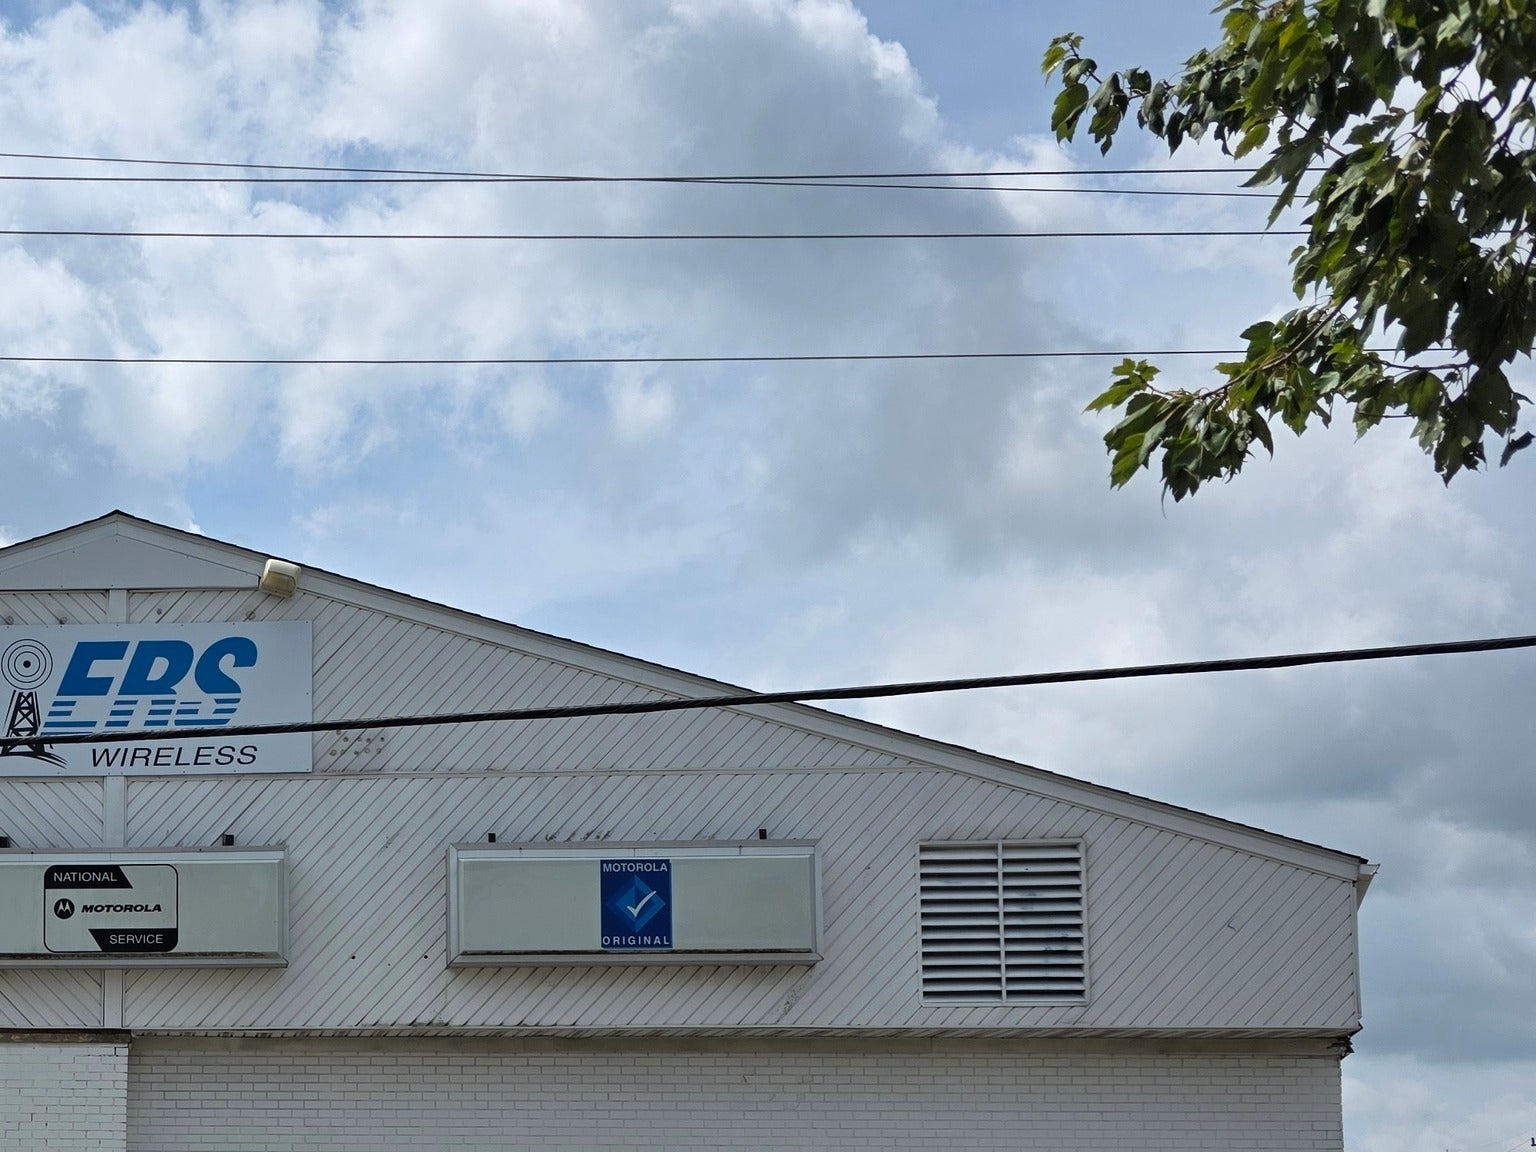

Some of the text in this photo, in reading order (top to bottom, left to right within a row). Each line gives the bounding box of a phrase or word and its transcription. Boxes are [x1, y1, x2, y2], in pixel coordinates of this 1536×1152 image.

[41, 636, 258, 735] ERS
[90, 745, 258, 768] WIRELESS
[603, 862, 668, 873] MOTOROLA
[53, 872, 118, 882] NATIONAL
[81, 903, 162, 913] MOTOROLA
[109, 934, 164, 944] SERVICE
[602, 935, 670, 945] ORIGINAL
